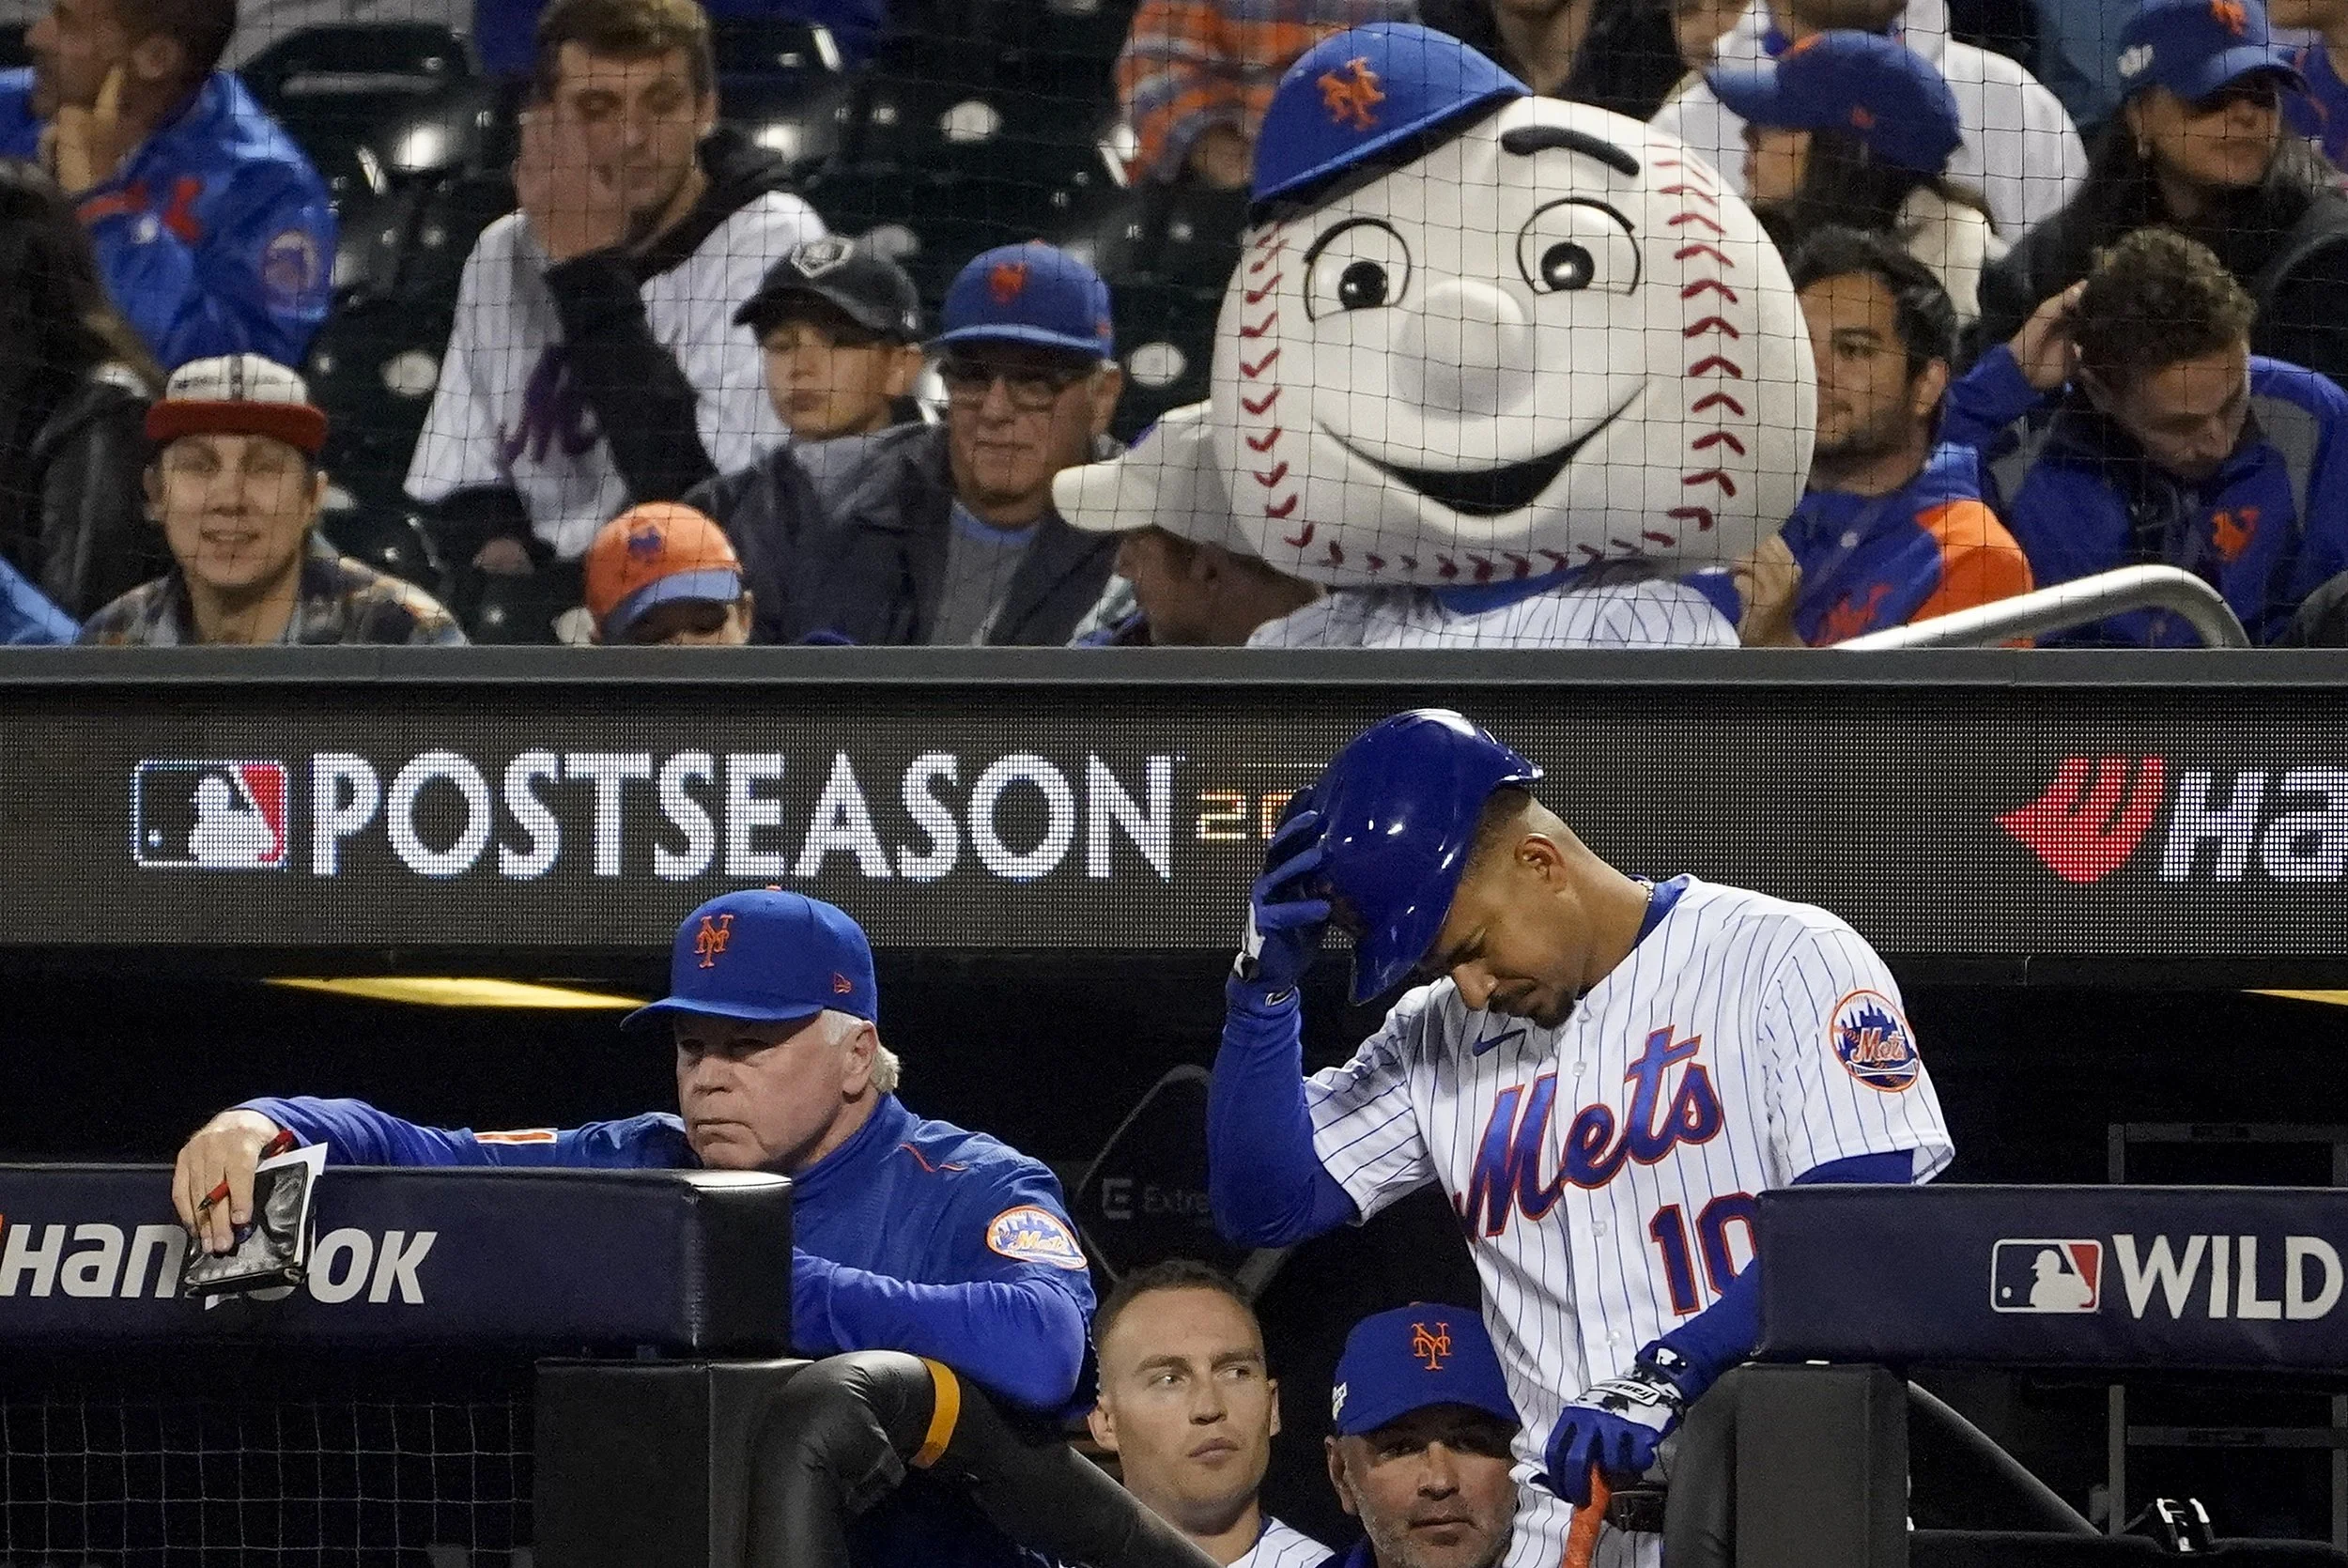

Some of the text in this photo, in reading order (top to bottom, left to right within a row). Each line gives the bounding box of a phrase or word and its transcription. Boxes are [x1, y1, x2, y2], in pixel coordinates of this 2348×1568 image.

[311, 749, 1173, 882] POSTSEASON
[694, 914, 734, 968] NY
[1849, 1026, 1908, 1064] Mets
[1454, 1024, 1722, 1242] Mets
[0, 1223, 438, 1309] Hanok
[1649, 1191, 1757, 1315] 10
[2111, 1233, 2344, 1319] WILD
[1411, 1322, 1452, 1371] NY
